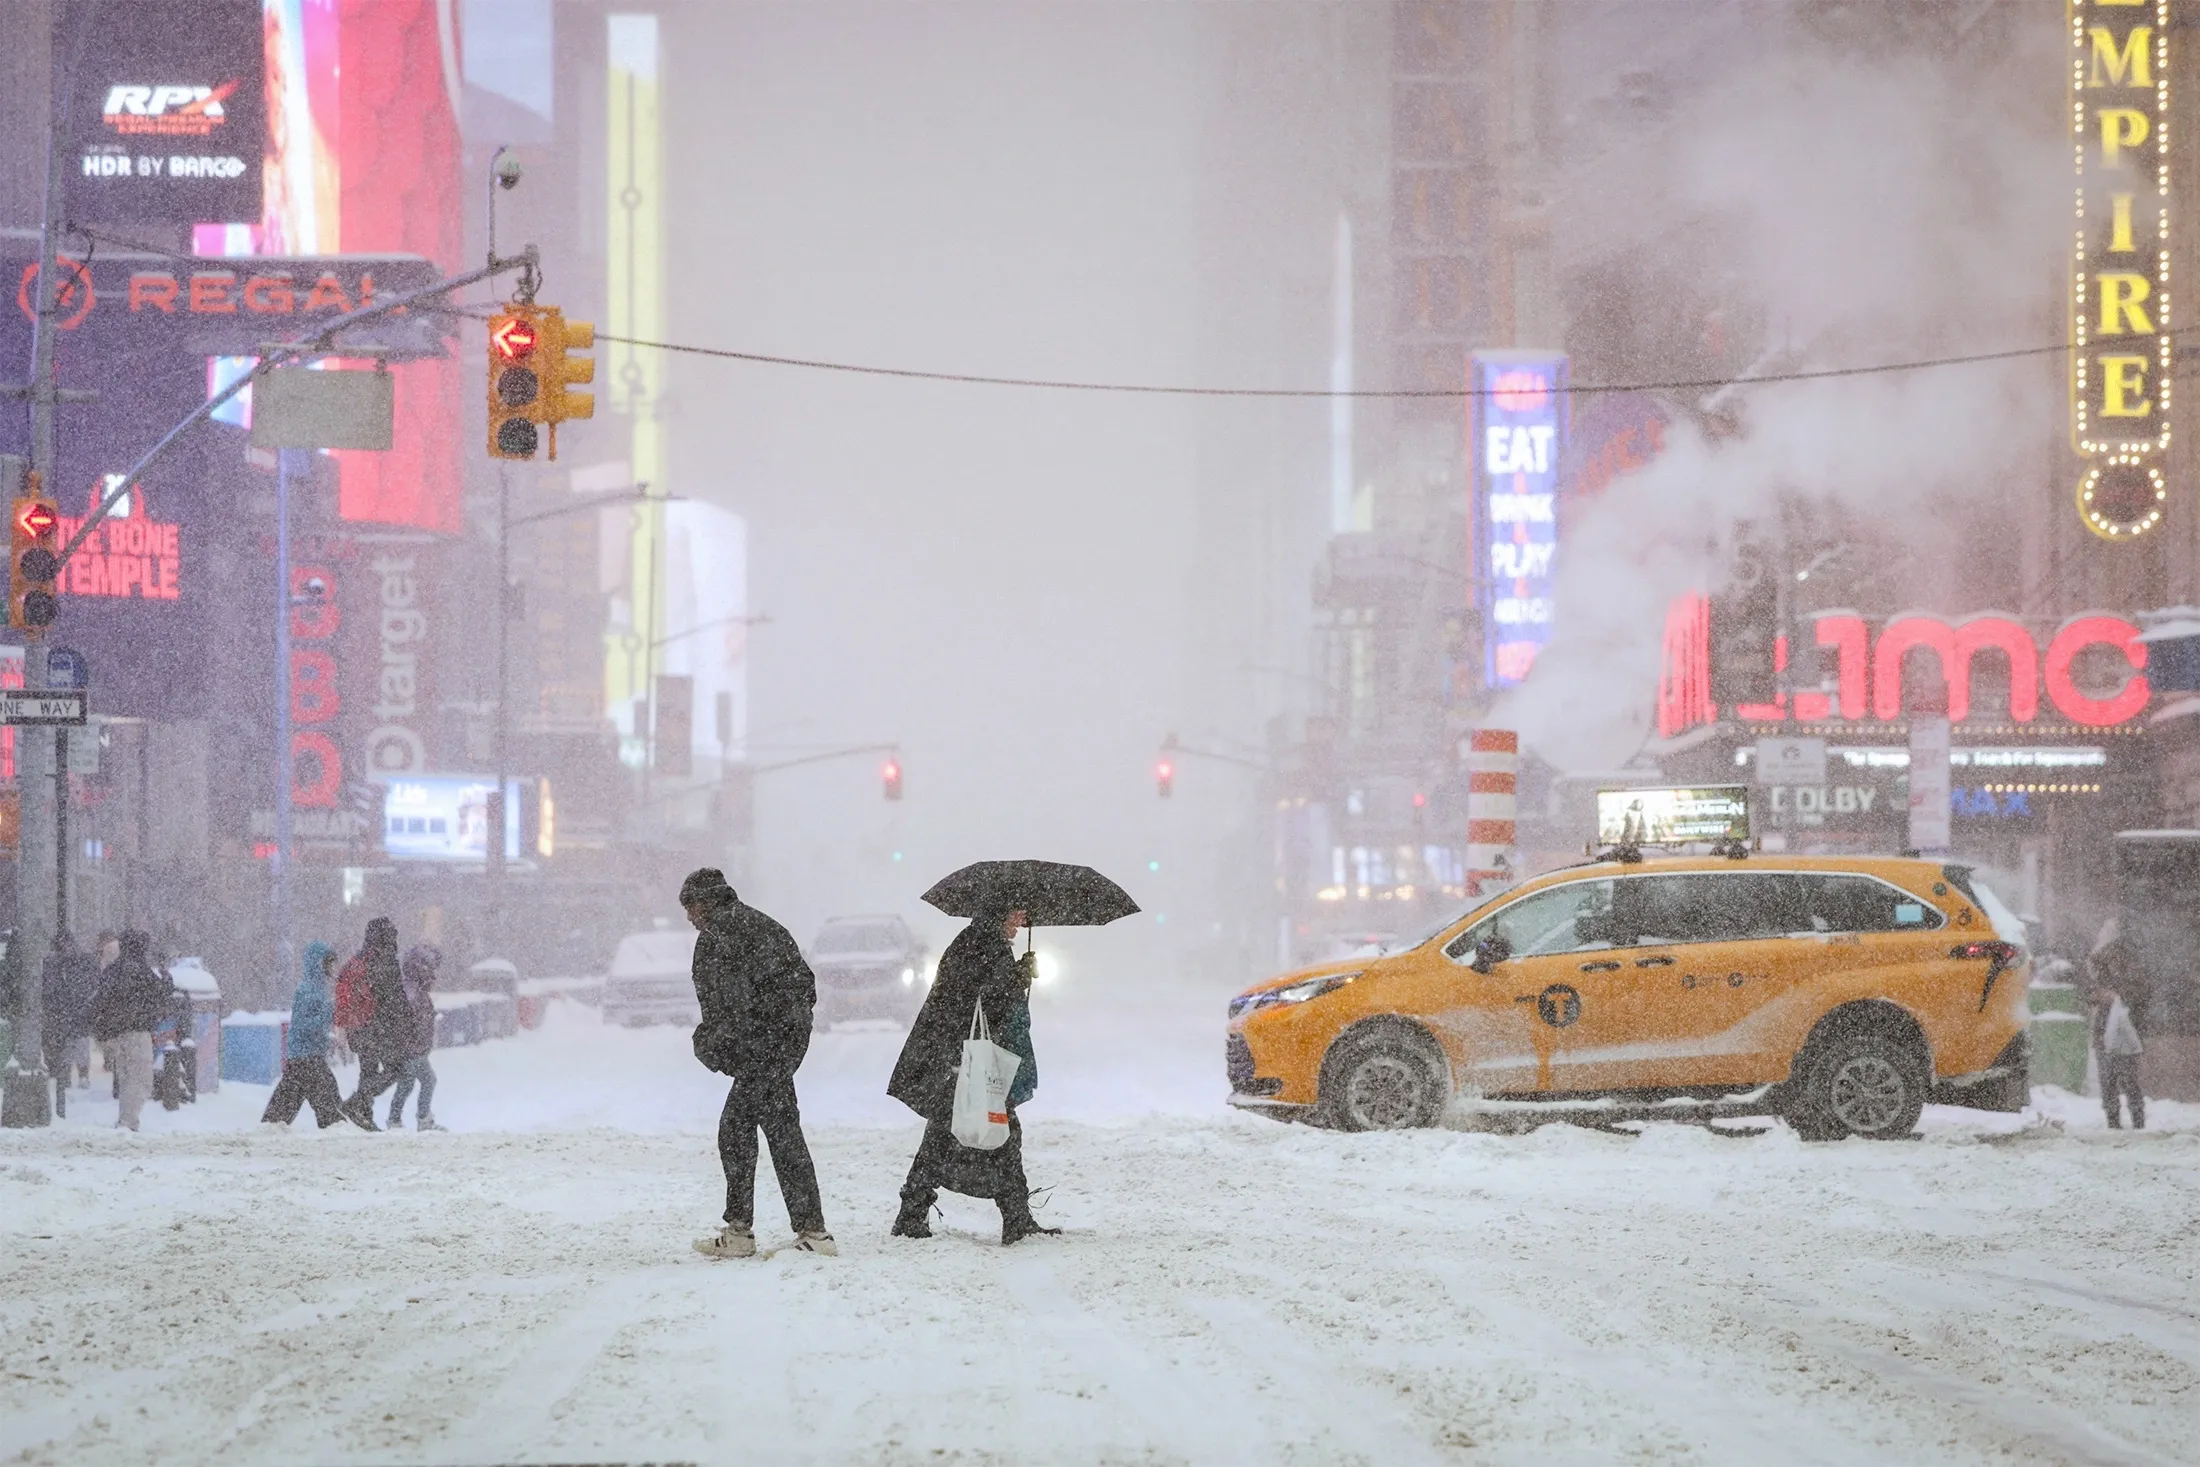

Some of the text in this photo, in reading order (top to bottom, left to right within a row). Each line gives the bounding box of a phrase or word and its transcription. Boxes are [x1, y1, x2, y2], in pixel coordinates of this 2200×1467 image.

[104, 81, 234, 116] RPX
[83, 155, 246, 178] HDR BY BARCO
[2086, 0, 2154, 417] MPIRE
[128, 276, 408, 314] REGAL
[1486, 426, 1555, 474] EAT
[109, 519, 179, 557] BONE
[1491, 542, 1556, 578] PLAY
[371, 556, 427, 720] target
[0, 701, 73, 715] NE WAY
